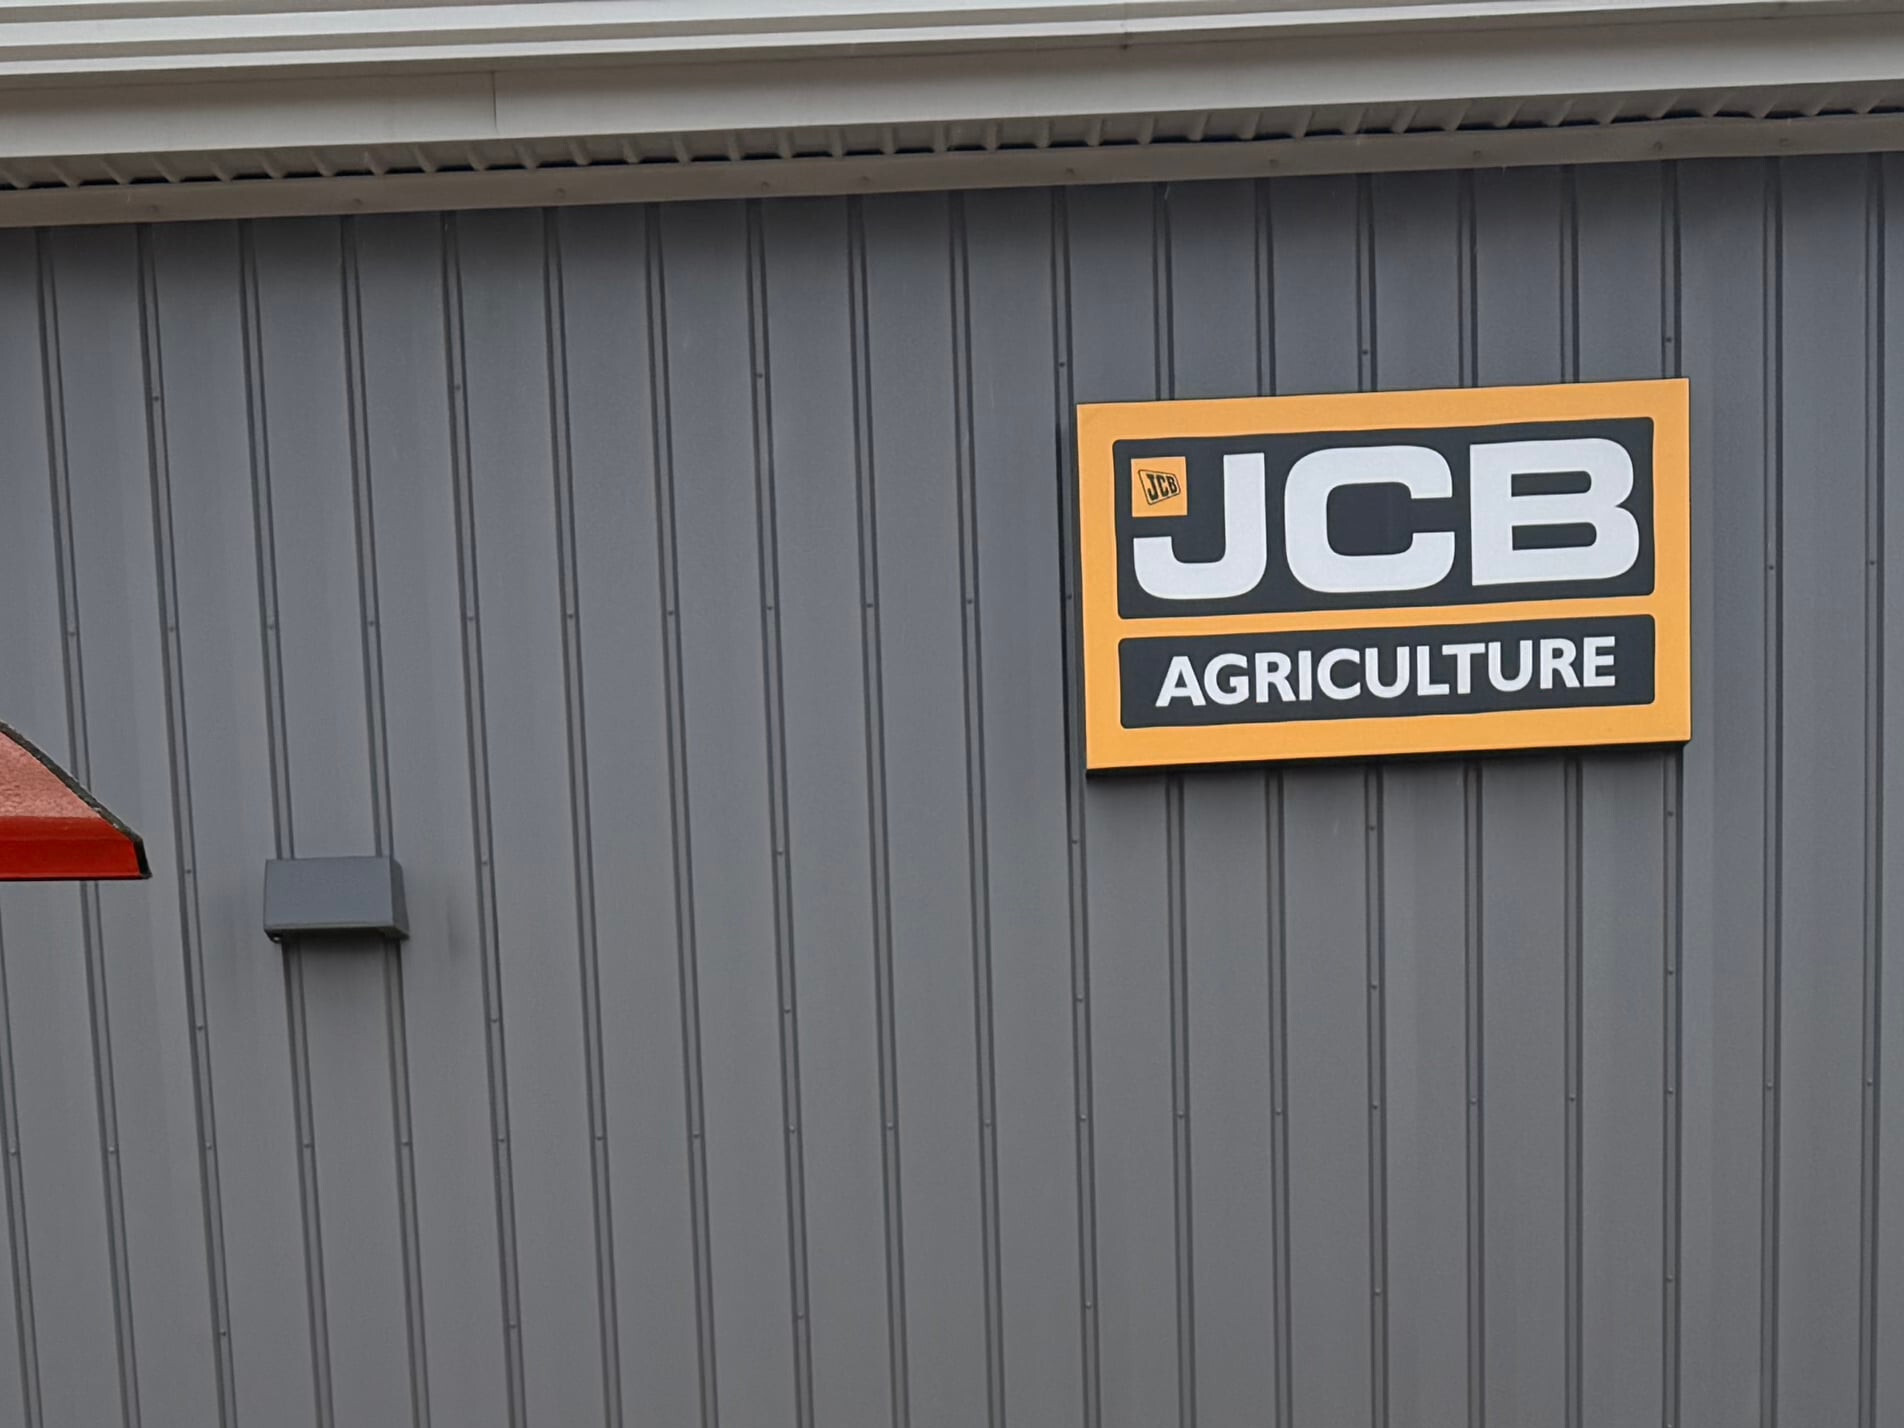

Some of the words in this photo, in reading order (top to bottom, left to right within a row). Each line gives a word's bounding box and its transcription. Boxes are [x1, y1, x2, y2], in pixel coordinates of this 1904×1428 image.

[1132, 437, 1641, 601] JCB
[1146, 473, 1178, 501] JCB
[1155, 635, 1617, 709] AGRICULTURE
